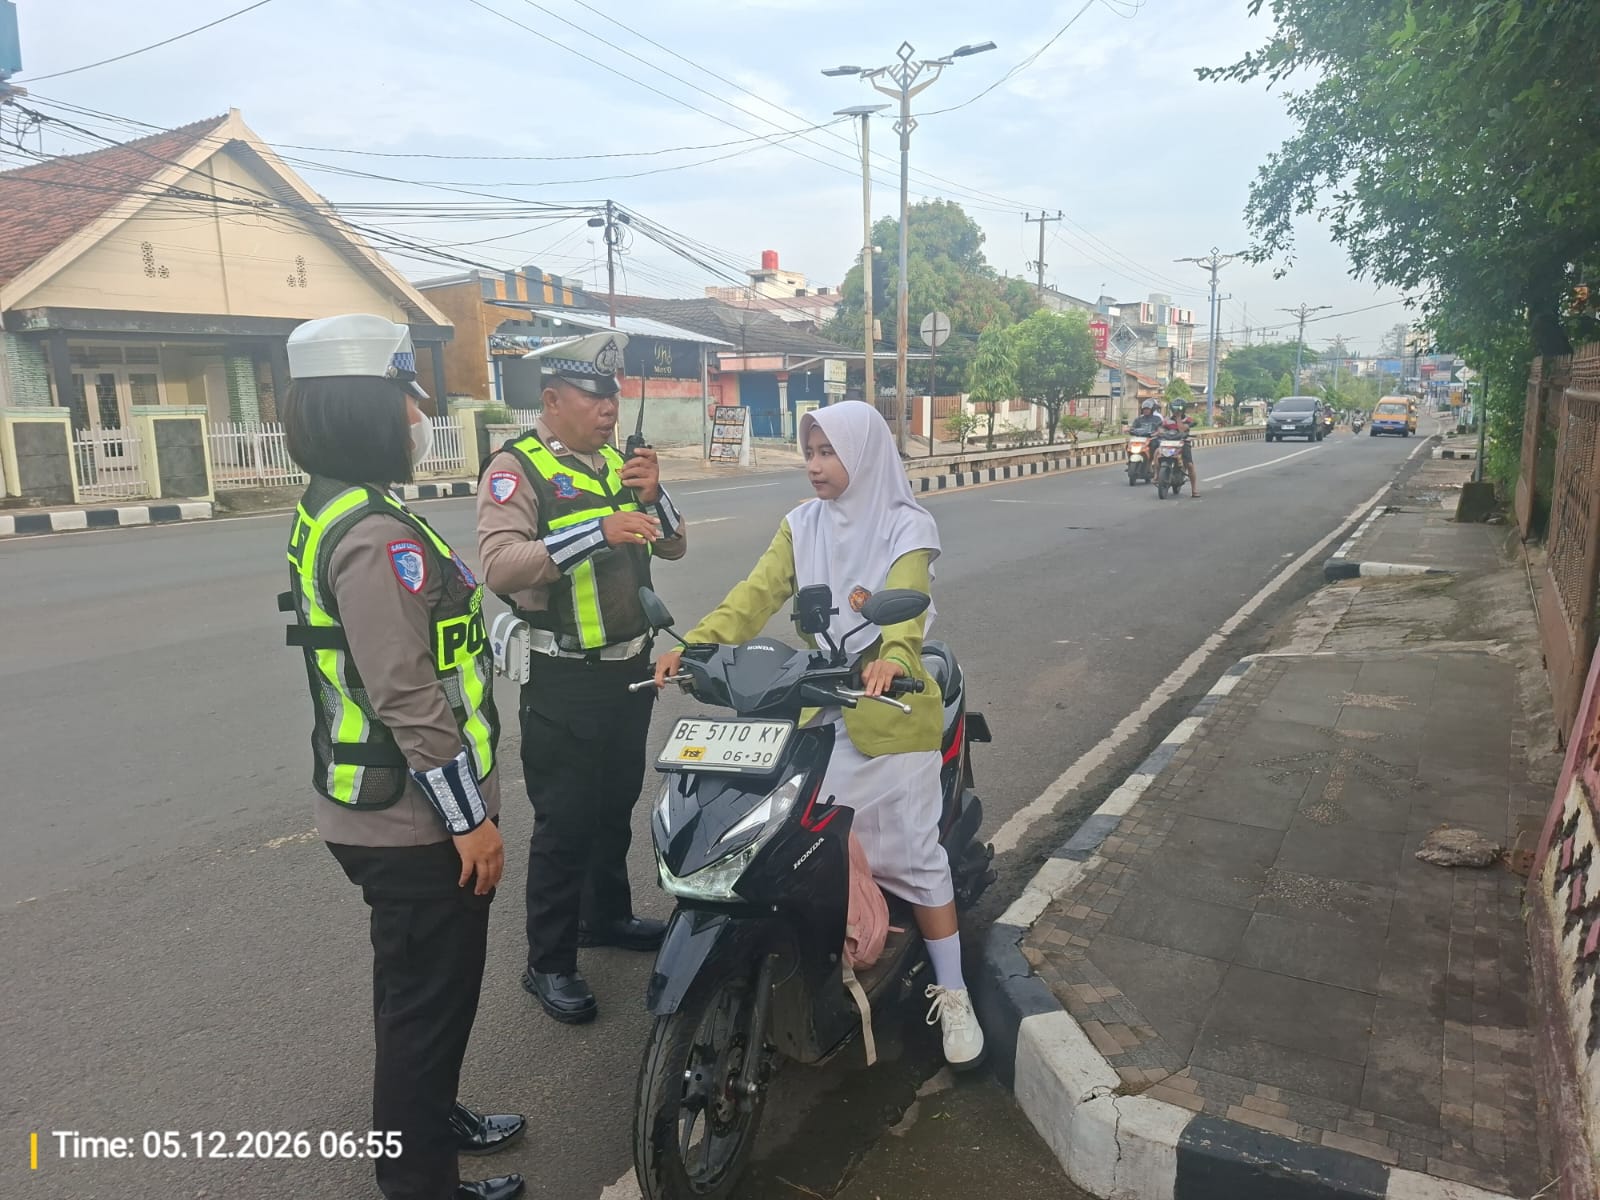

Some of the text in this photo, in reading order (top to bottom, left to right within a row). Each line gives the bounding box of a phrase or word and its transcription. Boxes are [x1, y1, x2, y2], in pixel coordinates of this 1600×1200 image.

[675, 722, 785, 744] BE 5110 KY
[793, 837, 825, 870] HONDA
